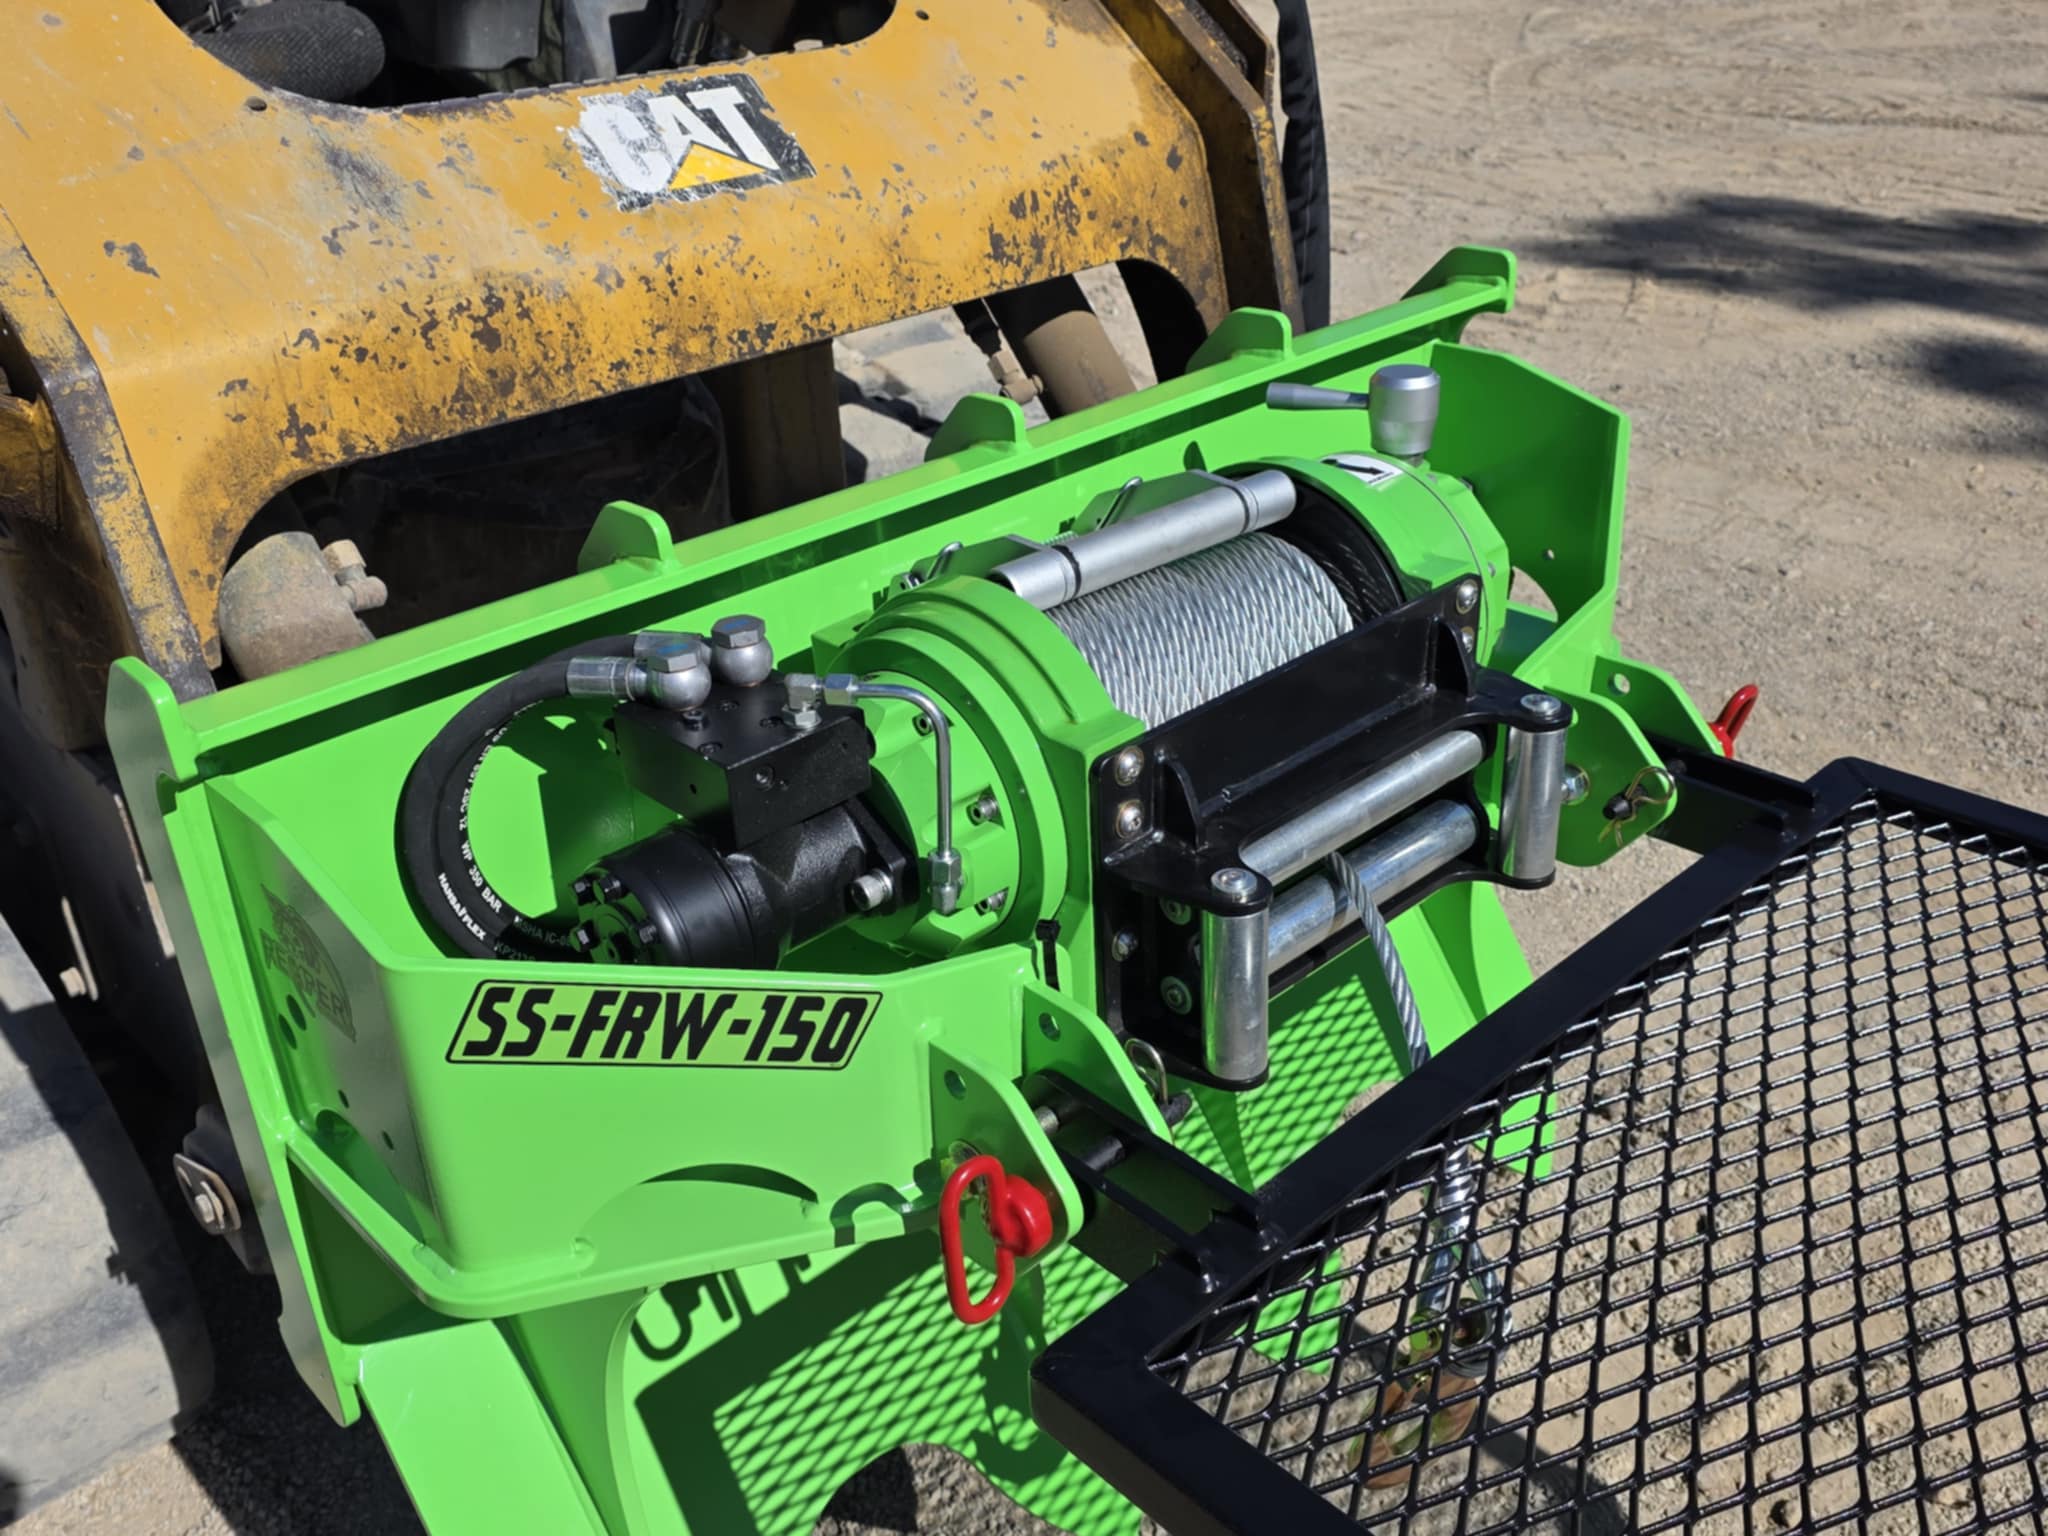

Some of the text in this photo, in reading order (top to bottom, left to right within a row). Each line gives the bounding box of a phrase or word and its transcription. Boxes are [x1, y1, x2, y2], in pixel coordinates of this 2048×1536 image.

[579, 86, 781, 193] CAT
[461, 840, 473, 861] WP
[468, 865, 484, 888] 350
[481, 886, 503, 914] BAR
[461, 986, 869, 1063] SS-FRW-150
